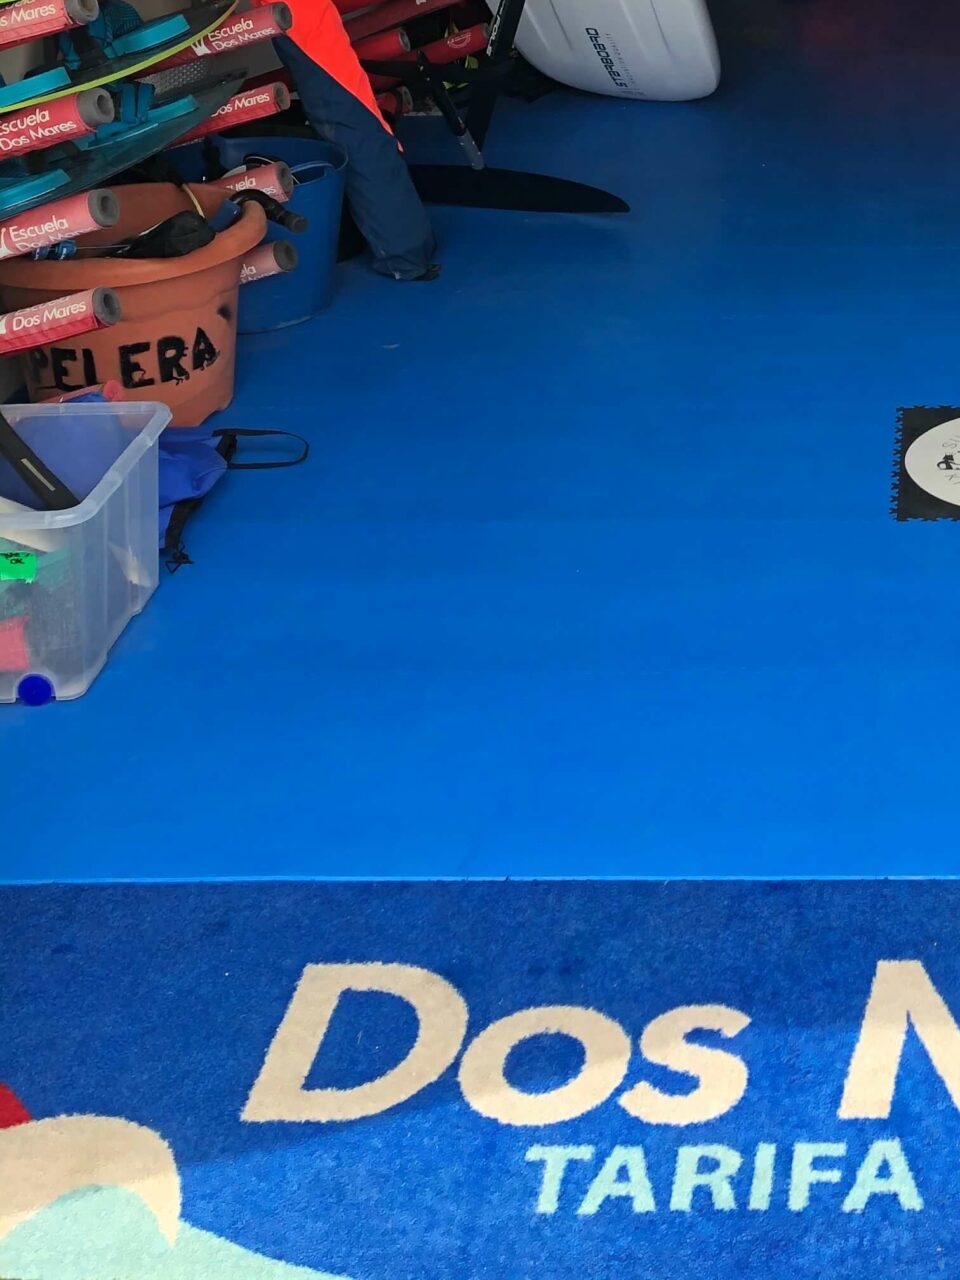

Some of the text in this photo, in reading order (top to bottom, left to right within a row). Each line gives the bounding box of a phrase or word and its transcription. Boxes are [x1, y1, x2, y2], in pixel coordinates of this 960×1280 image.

[11, 3, 56, 25] Mares
[208, 18, 254, 42] Escuela
[212, 26, 276, 52] Dos Mares
[234, 92, 270, 111] Mares
[0, 120, 77, 151] Dos Mares
[9, 216, 68, 242] Escuela
[12, 313, 40, 332] Dos
[42, 301, 87, 323] Mares
[239, 960, 752, 1127] Dos
[524, 1137, 925, 1214] TARIFA
